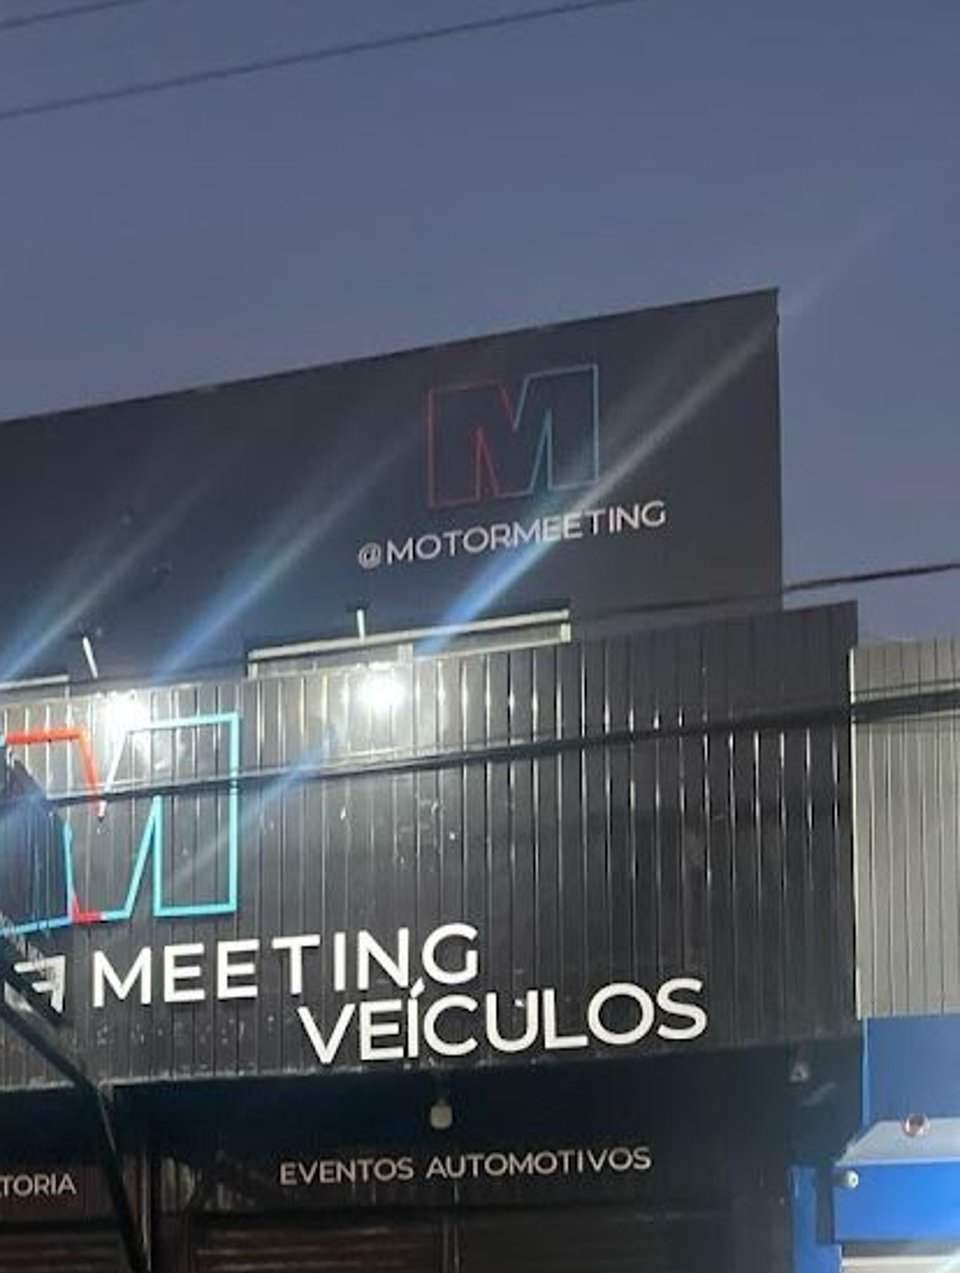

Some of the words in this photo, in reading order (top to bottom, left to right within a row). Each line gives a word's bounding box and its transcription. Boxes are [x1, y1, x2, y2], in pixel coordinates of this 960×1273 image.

[357, 500, 668, 570] @MOTORMEETING
[92, 922, 479, 1010] MEETING
[296, 977, 708, 1065] VEÍCULOS
[279, 1157, 414, 1186] EVENTOS
[425, 1146, 653, 1180] AUTOMOTIVOS
